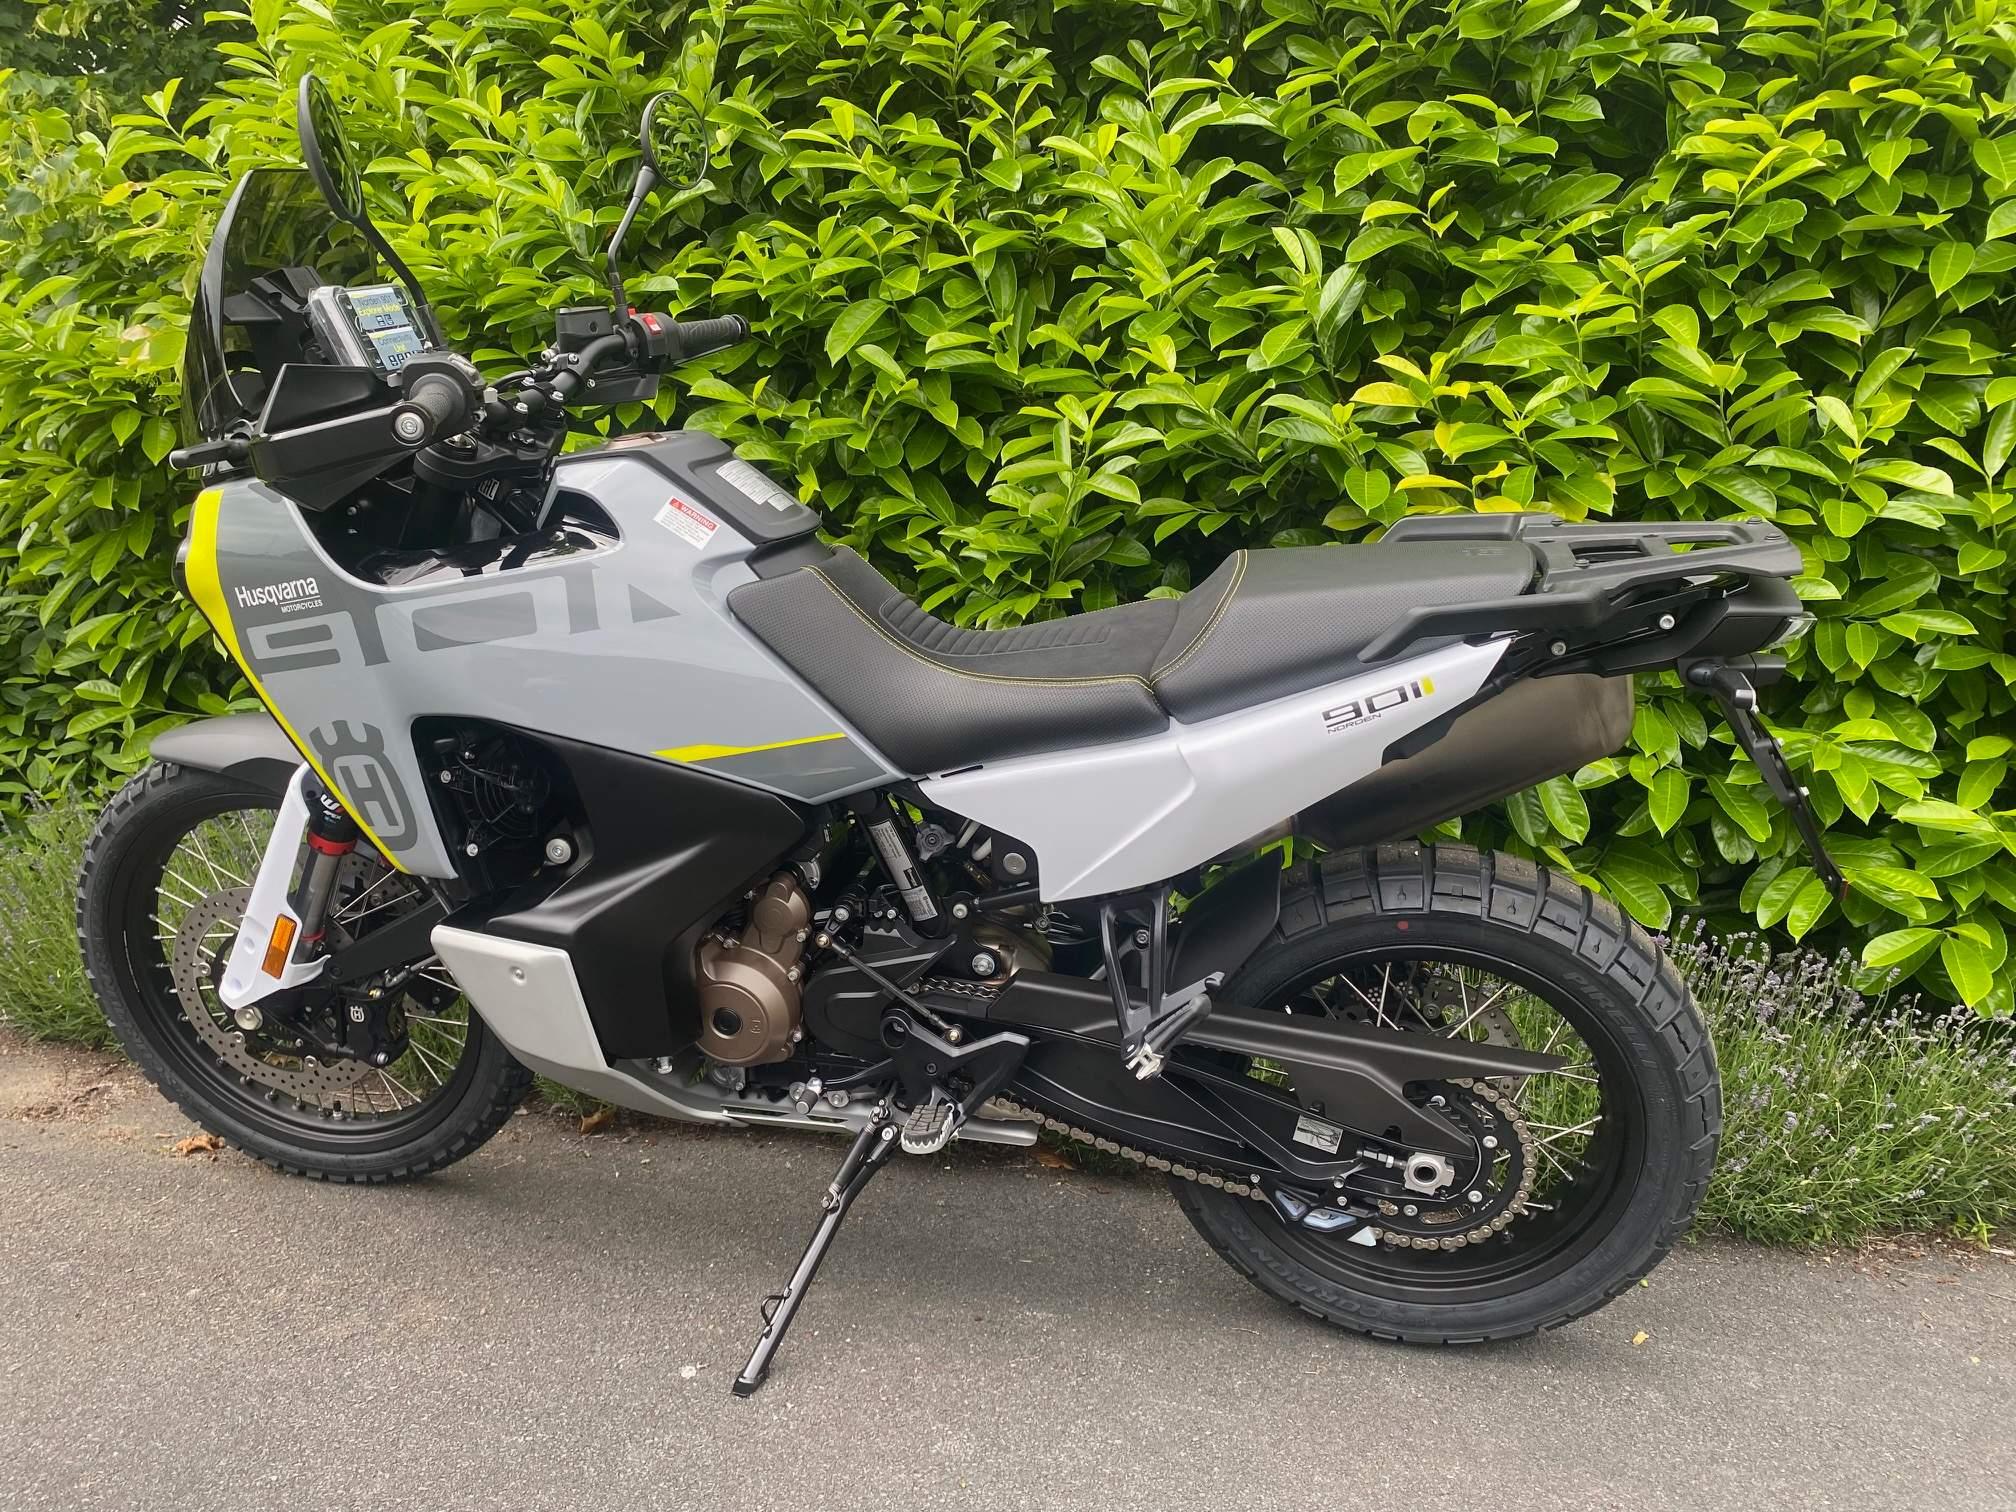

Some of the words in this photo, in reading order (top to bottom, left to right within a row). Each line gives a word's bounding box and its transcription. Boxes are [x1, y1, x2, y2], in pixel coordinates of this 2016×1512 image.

[680, 503, 715, 530] WARNING
[234, 577, 319, 608] Husqvarna
[280, 599, 324, 613] MOTORCYCLES
[1322, 680, 1422, 728] 901
[1327, 712, 1382, 735] NORDEN
[1562, 971, 1660, 1070] PIRELLI
[1248, 1244, 1406, 1324] SCORPION
